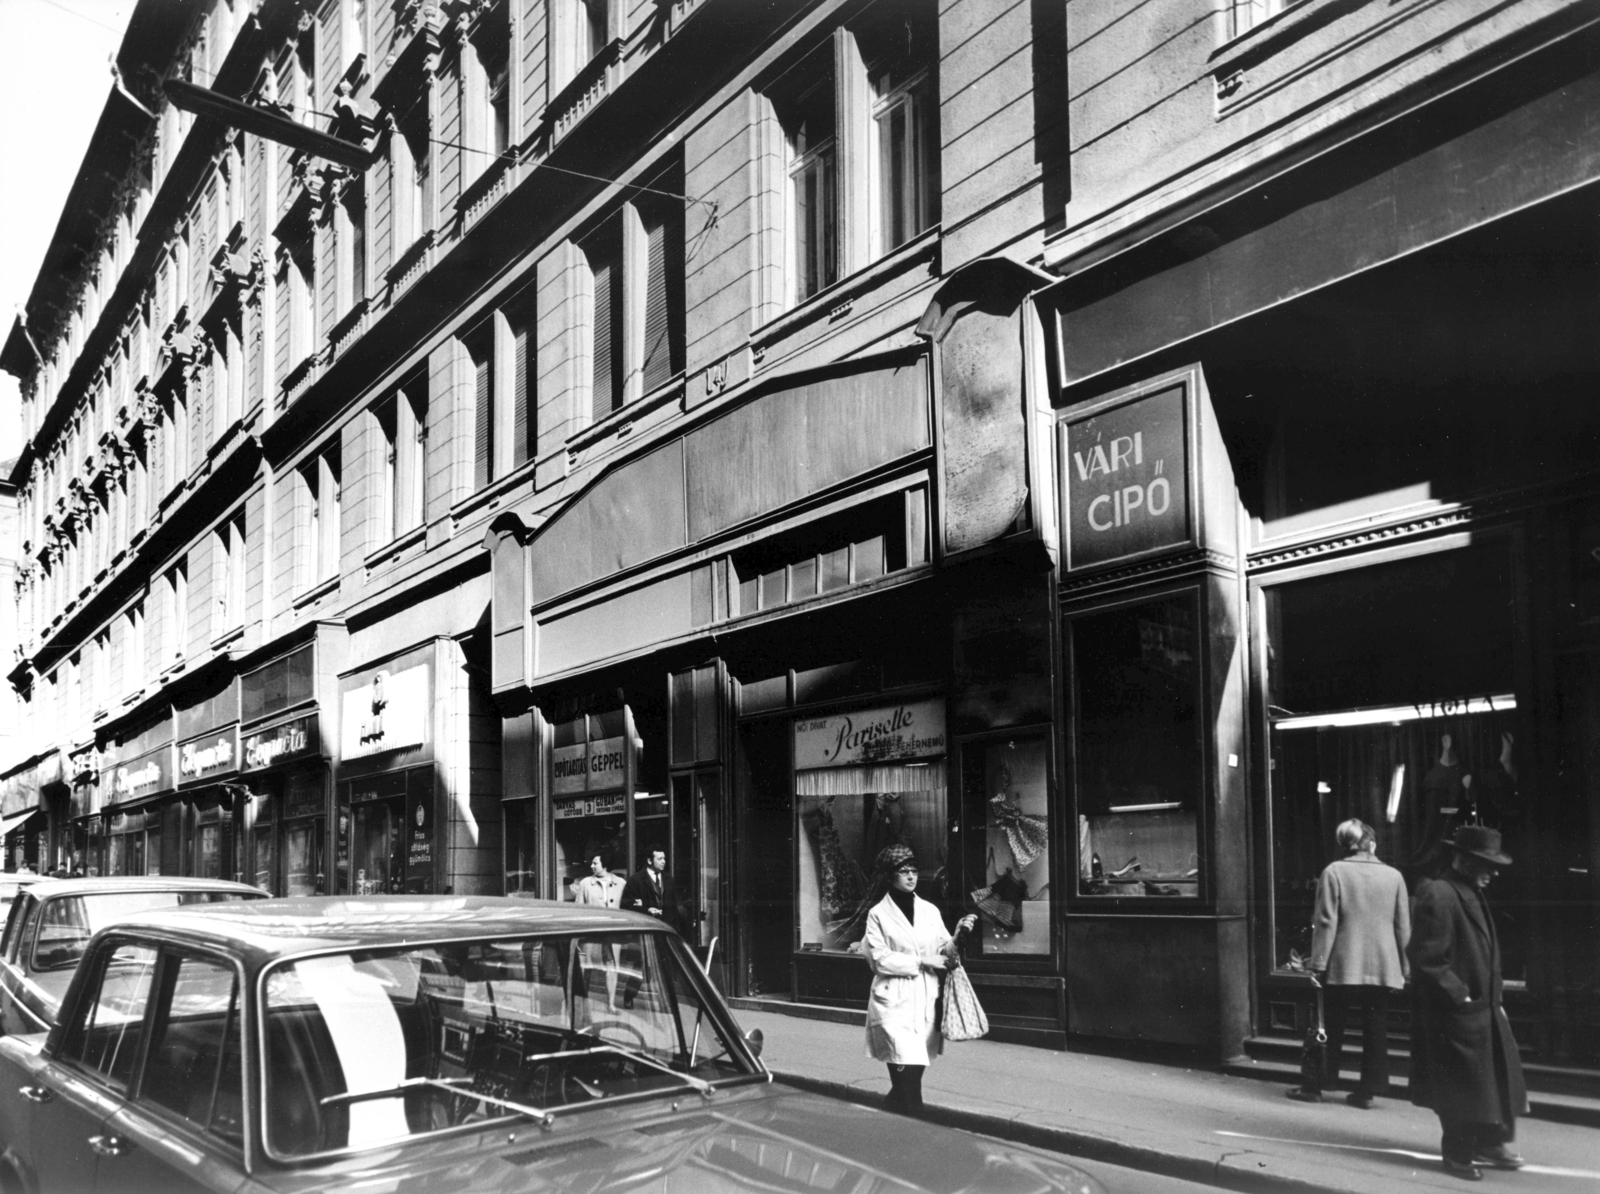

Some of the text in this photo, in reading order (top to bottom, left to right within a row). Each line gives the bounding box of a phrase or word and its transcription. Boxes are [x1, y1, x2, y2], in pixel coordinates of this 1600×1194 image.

[1074, 431, 1142, 481] VÁRI
[1088, 459, 1170, 531] CIPŐ
[810, 720, 827, 731] DIVAT
[591, 750, 624, 773] GÉPPEL
